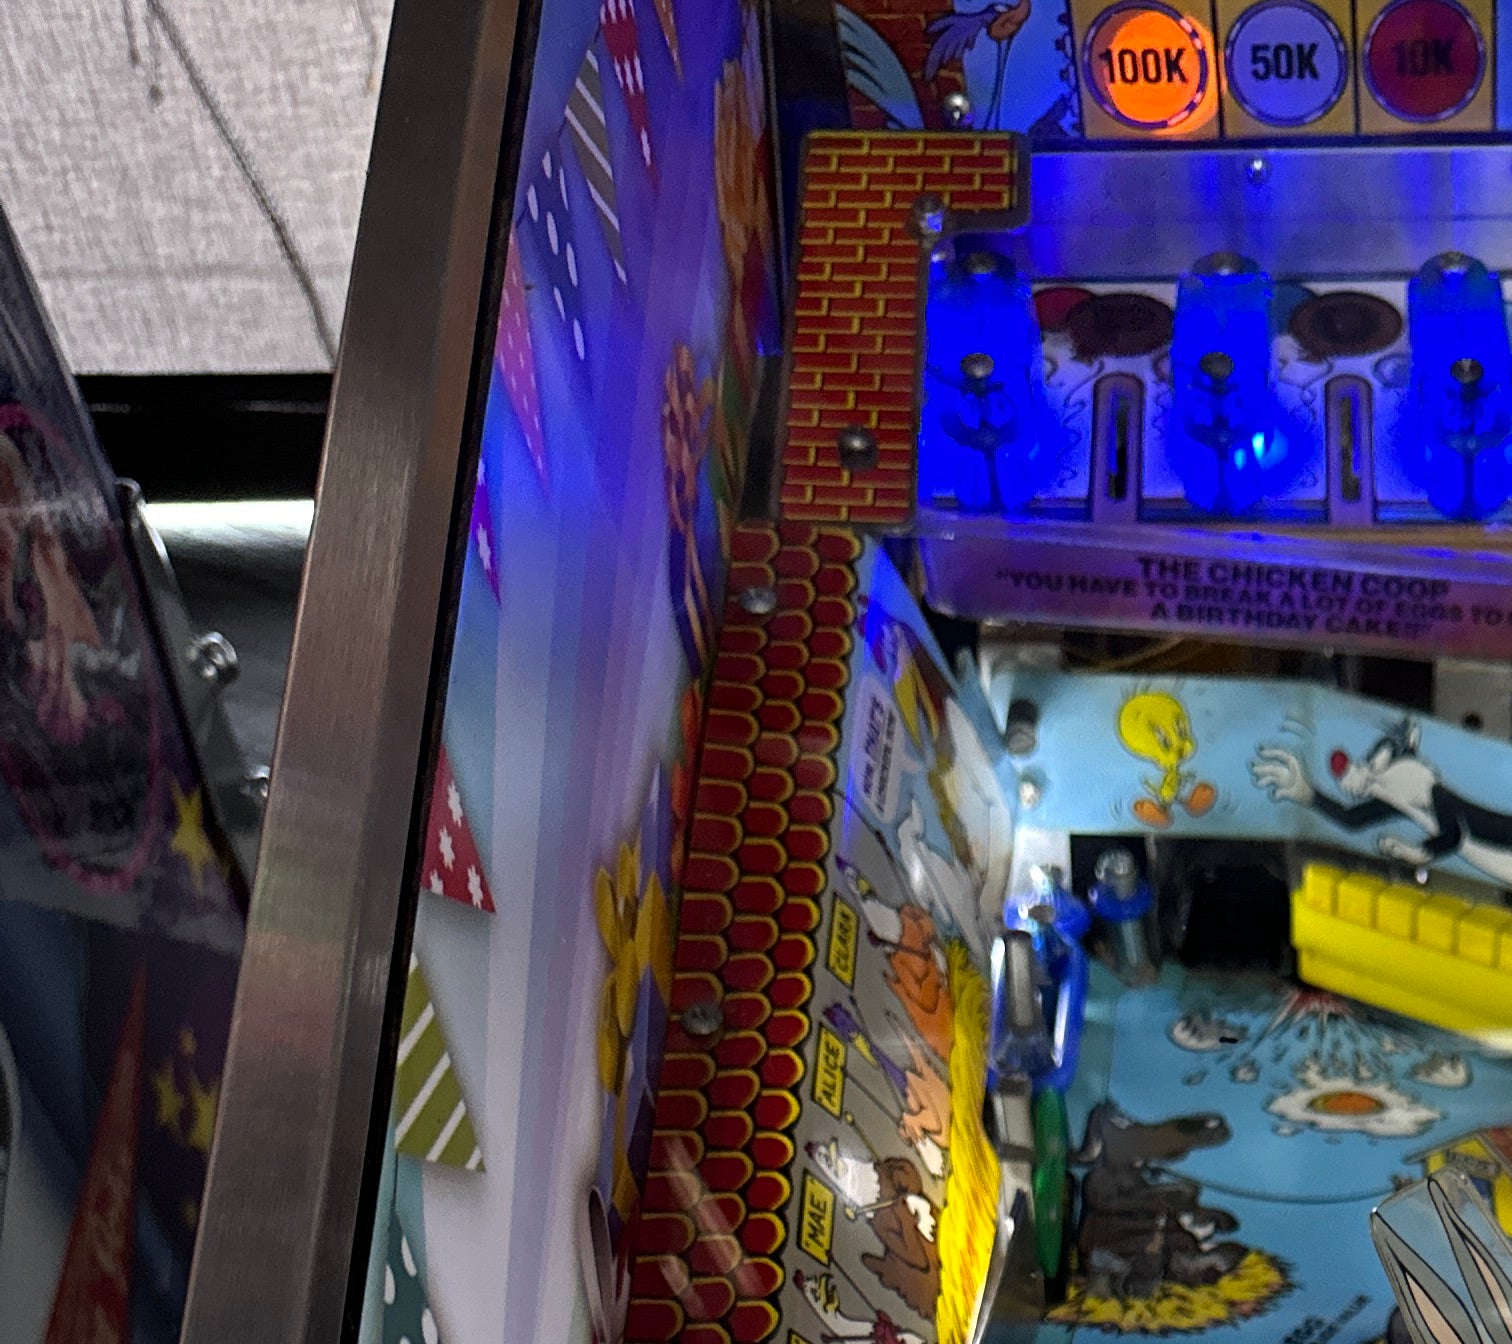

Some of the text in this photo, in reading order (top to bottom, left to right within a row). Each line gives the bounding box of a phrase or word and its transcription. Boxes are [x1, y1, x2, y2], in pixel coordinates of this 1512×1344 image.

[1100, 49, 1188, 85] 100K
[1250, 43, 1320, 81] 50K
[1392, 38, 1456, 76] 10K
[1138, 556, 1451, 601] THE CHICKEN COOP
[1068, 575, 1137, 597] HAVE
[1146, 582, 1181, 600] TO
[1470, 604, 1503, 625] TO
[1175, 603, 1319, 632] BIRTHDAY
[822, 1035, 842, 1108] ALICE
[805, 1196, 830, 1246] MAE
